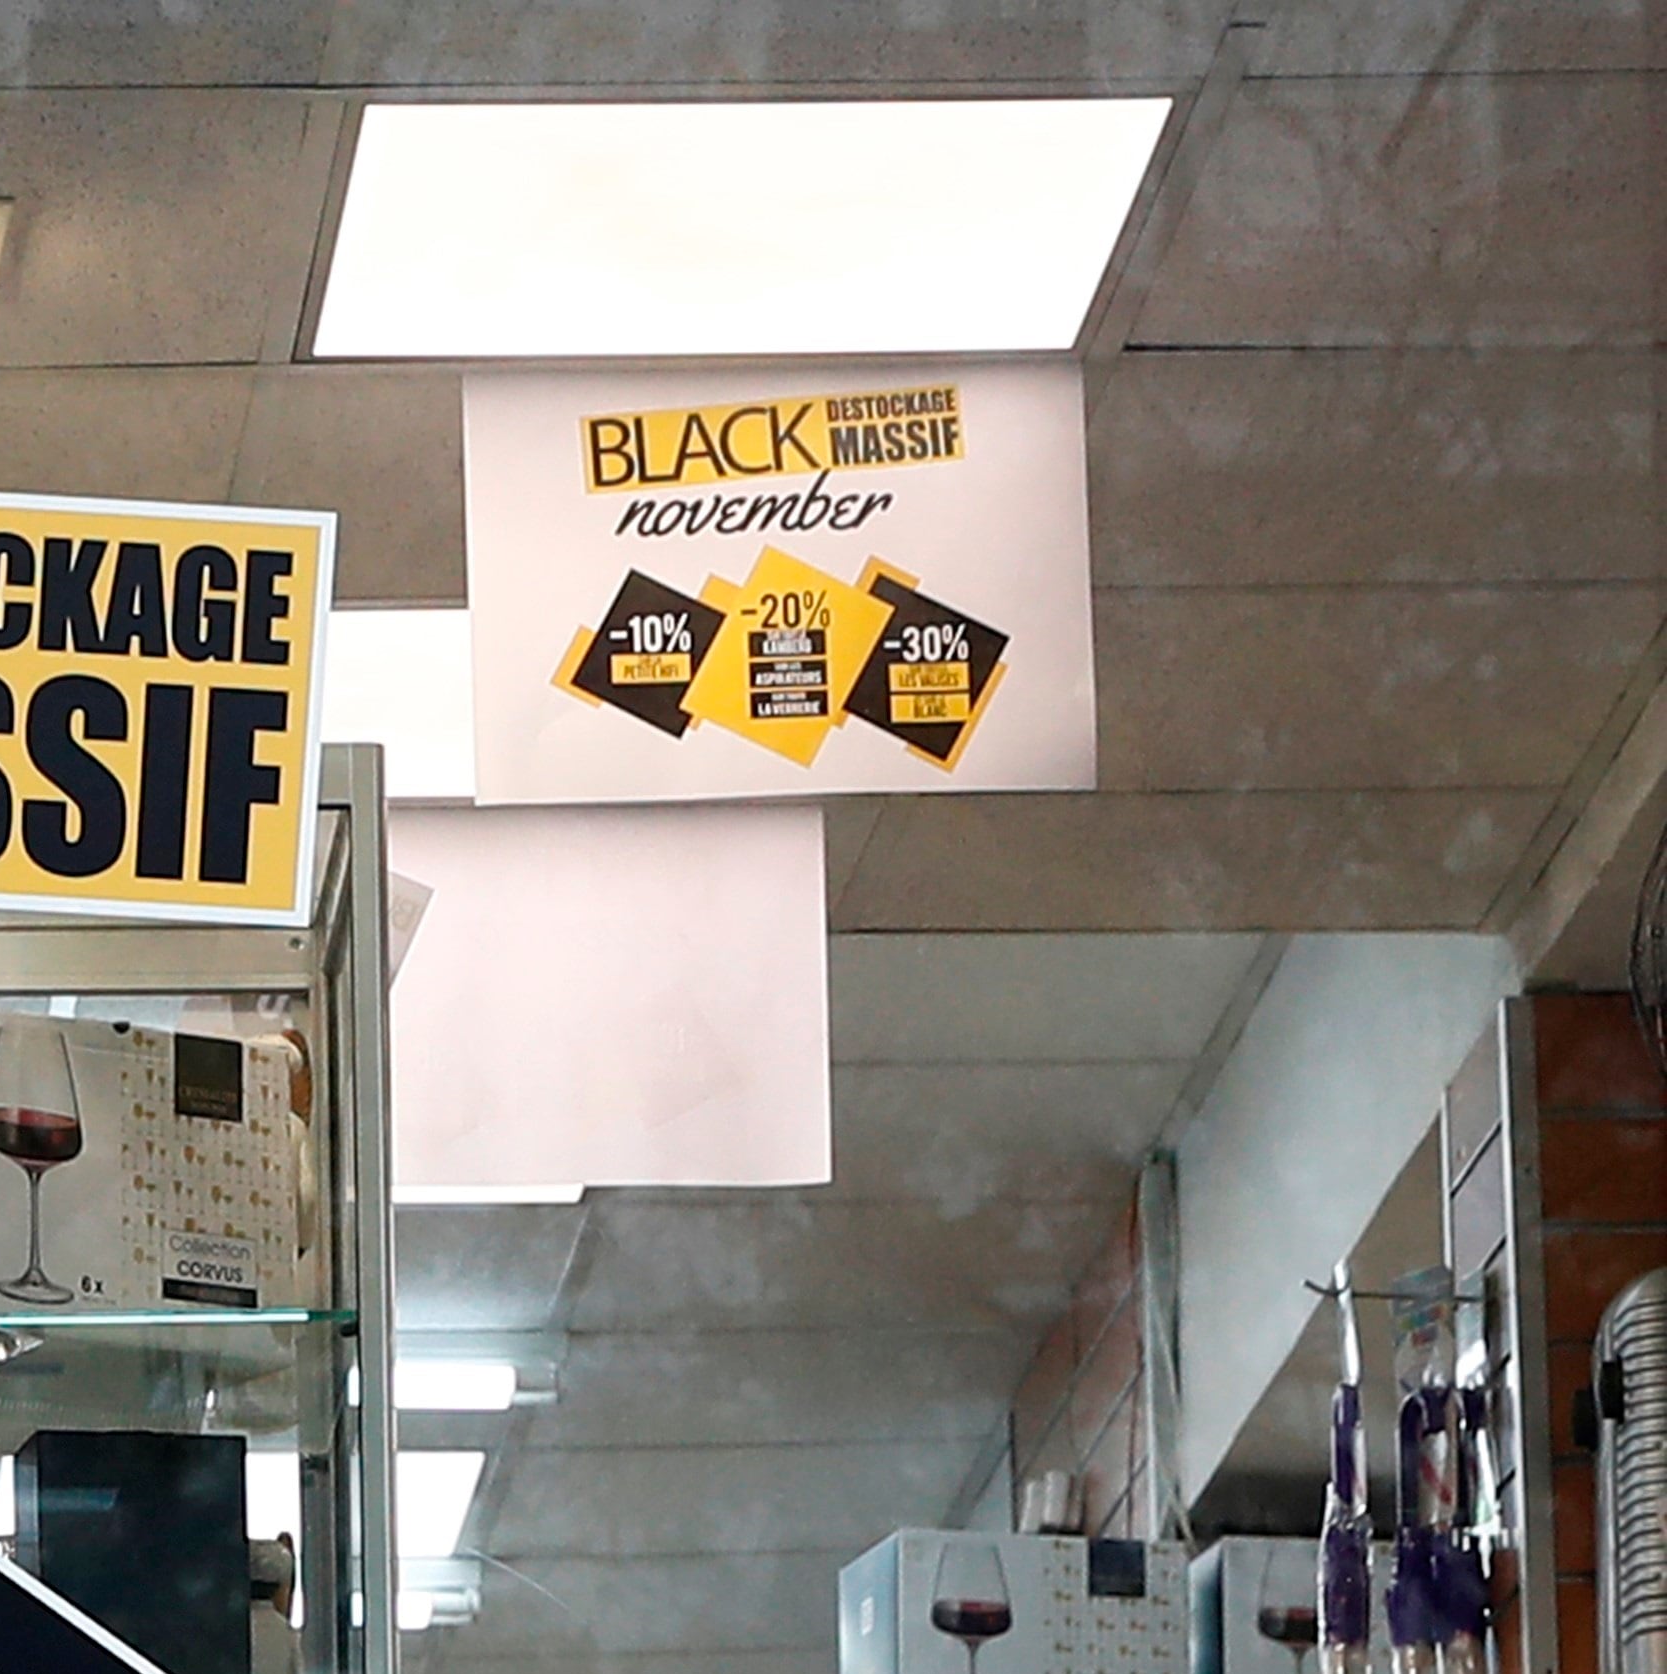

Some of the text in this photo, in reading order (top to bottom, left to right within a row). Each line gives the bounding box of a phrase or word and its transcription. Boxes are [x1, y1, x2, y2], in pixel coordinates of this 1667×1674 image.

[826, 389, 956, 423] DESTOCKAGE
[589, 403, 820, 487] BLACK
[829, 417, 959, 467] MASSIF
[615, 469, 893, 537] november
[741, 590, 830, 629] -20%
[609, 613, 692, 653] -10%
[883, 623, 969, 661] -30%
[169, 1233, 251, 1261] Collection
[177, 1259, 243, 1283] CORVUS
